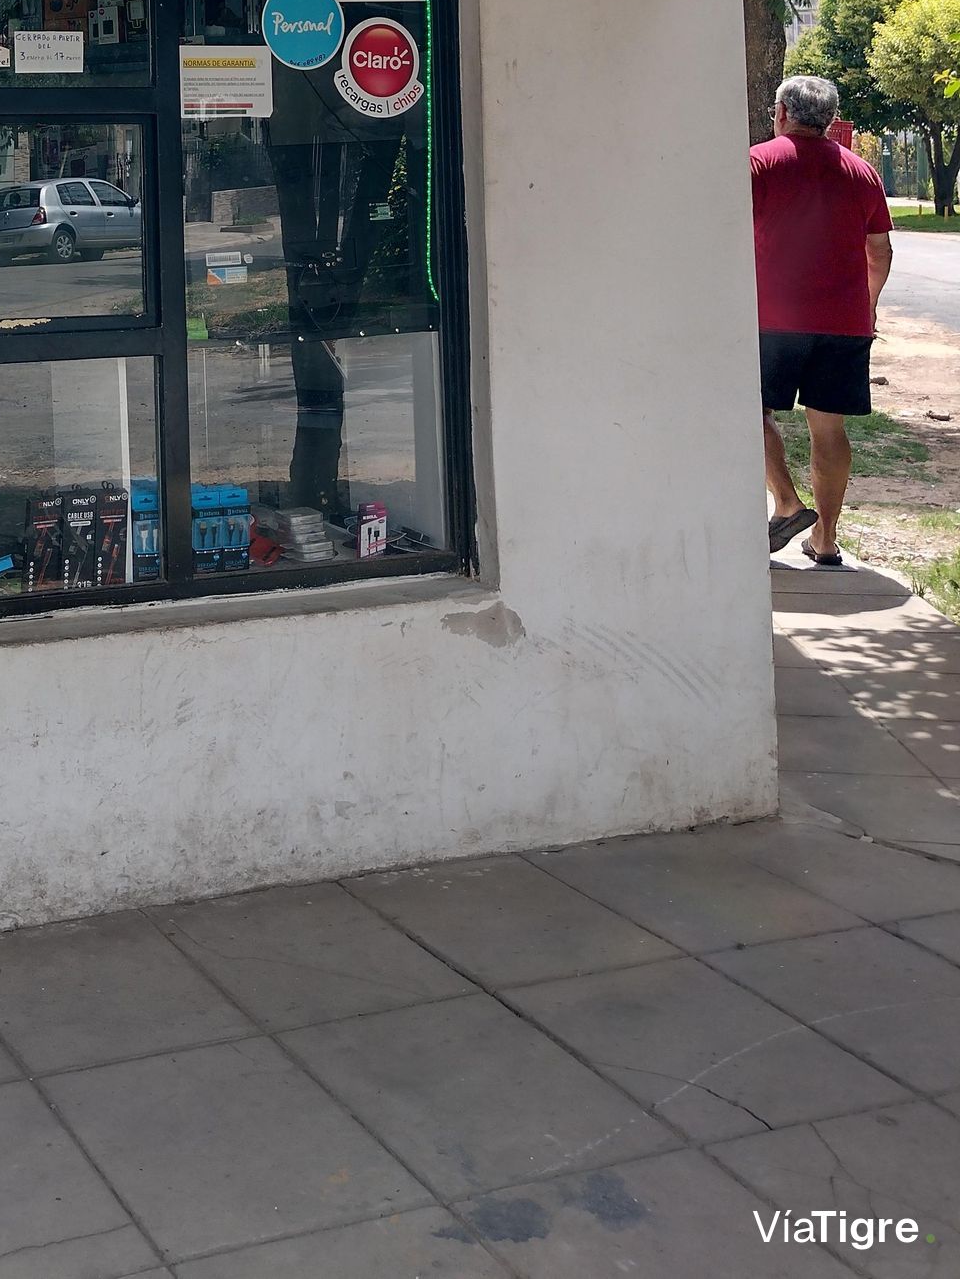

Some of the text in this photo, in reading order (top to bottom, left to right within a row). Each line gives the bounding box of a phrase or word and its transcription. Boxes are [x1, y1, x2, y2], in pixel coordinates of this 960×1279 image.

[271, 12, 334, 36] Personal
[183, 59, 211, 67] NORMAS
[212, 59, 220, 67] DE
[353, 49, 402, 70] Claro
[337, 74, 421, 113] recargas chips
